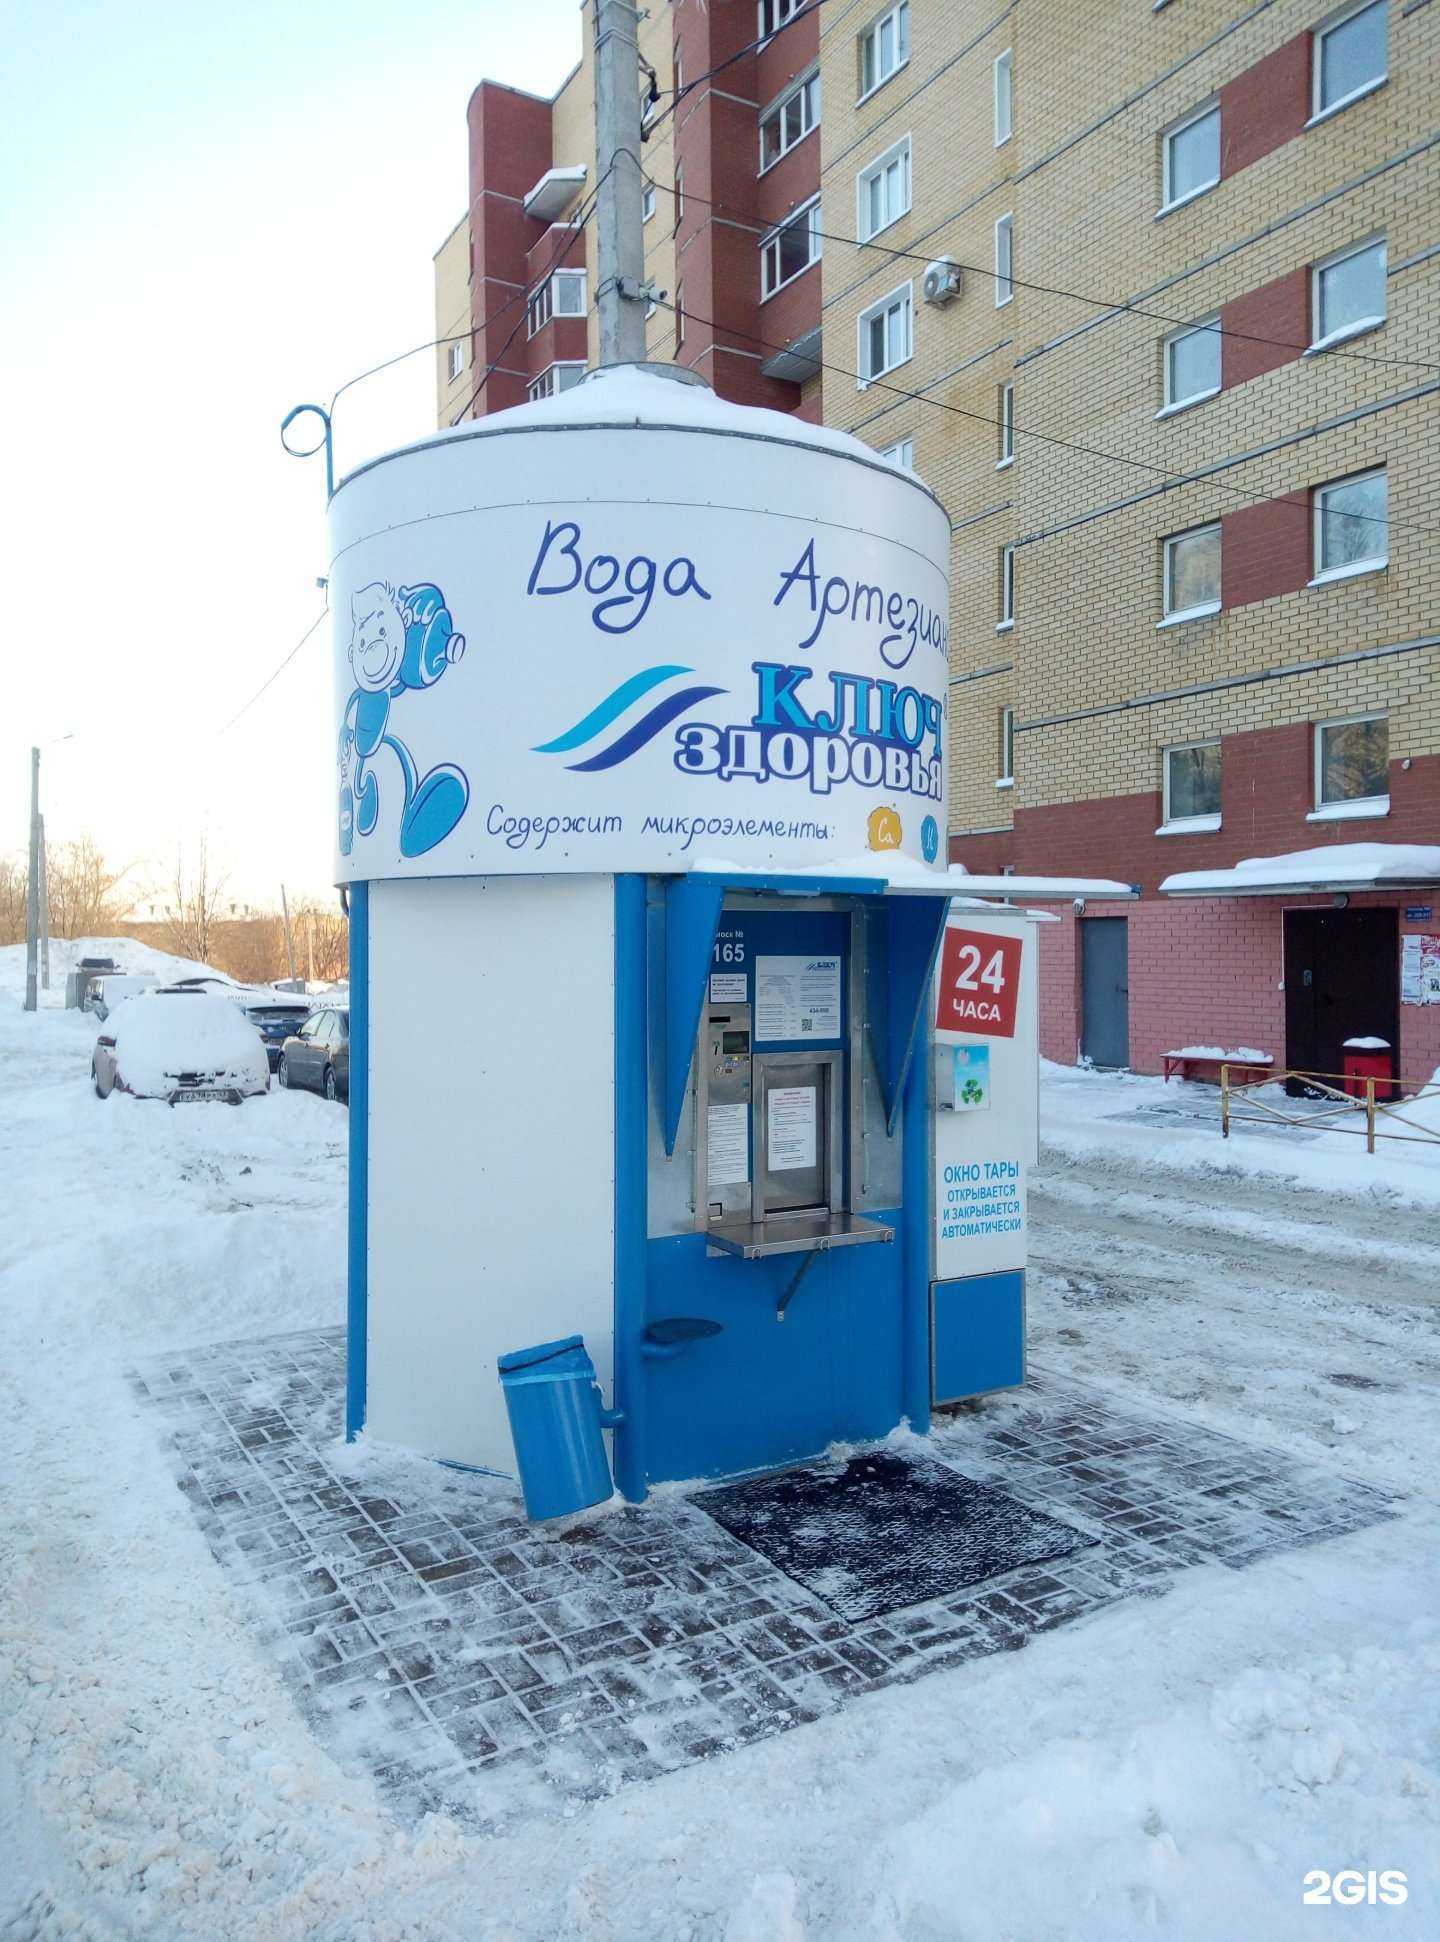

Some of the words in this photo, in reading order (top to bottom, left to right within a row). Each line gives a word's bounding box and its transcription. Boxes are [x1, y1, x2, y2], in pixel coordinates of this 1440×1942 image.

[527, 519, 712, 634] Вода
[773, 537, 949, 670] Артезиан
[751, 661, 942, 760] КЛЮЧ
[486, 804, 622, 850] Содержит
[641, 814, 836, 850] микроэлементы:
[713, 943, 745, 962] 165
[955, 944, 1005, 994] 24
[953, 998, 1001, 1022] ЧАСА
[944, 1164, 980, 1183] ОКНО
[983, 1161, 1019, 1180] ТАРЫ
[947, 1184, 1016, 1202] ОТКРЫВАЕТСЯ
[943, 1208, 950, 1220] И
[952, 1200, 1020, 1220] ЗАКРЫВАЕТСЯ
[941, 1218, 1021, 1239] АВТОМАТИЧЕСКИ
